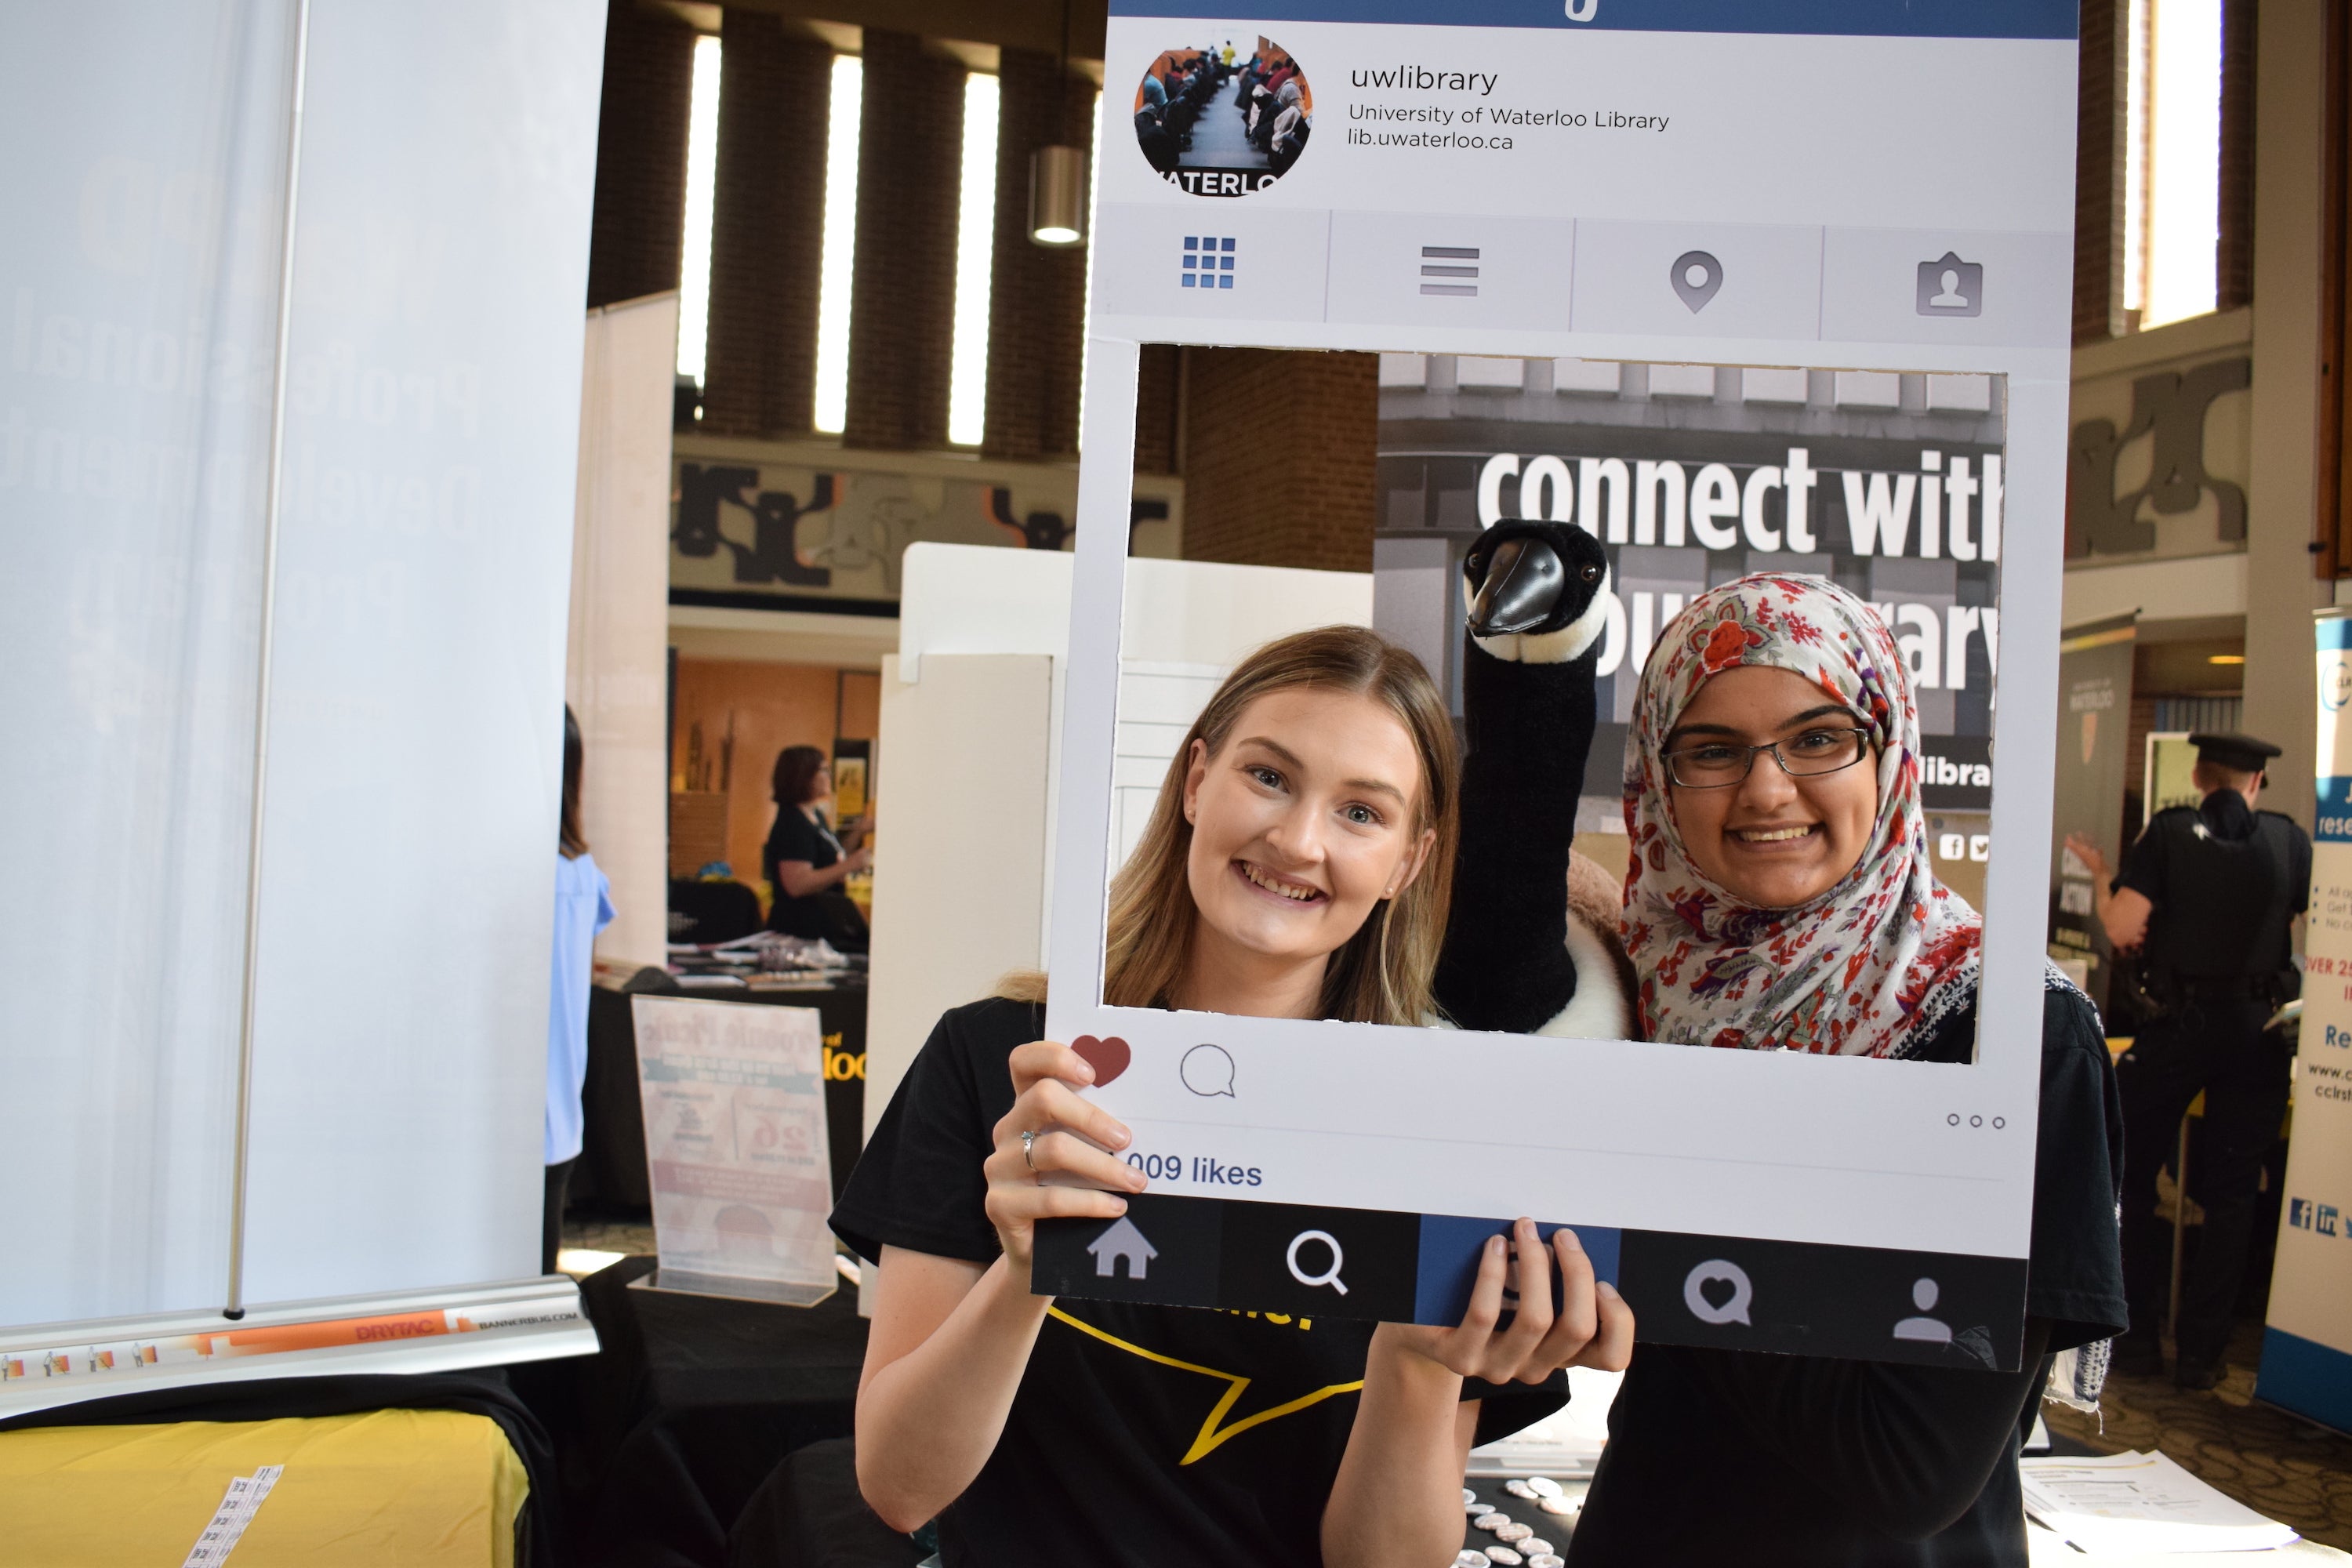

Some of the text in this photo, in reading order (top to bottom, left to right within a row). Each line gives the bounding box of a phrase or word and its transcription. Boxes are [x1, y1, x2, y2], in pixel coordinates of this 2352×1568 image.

[1351, 64, 1499, 96] uwlibrary
[1348, 103, 1671, 132] University of Waterloo Library
[1348, 128, 1513, 151] lib.uwaterloo.ca
[1160, 171, 1279, 195] ATERLO
[1478, 448, 1817, 554] connect
[1192, 1156, 1262, 1187] likes
[355, 1319, 435, 1341] DRYTAC
